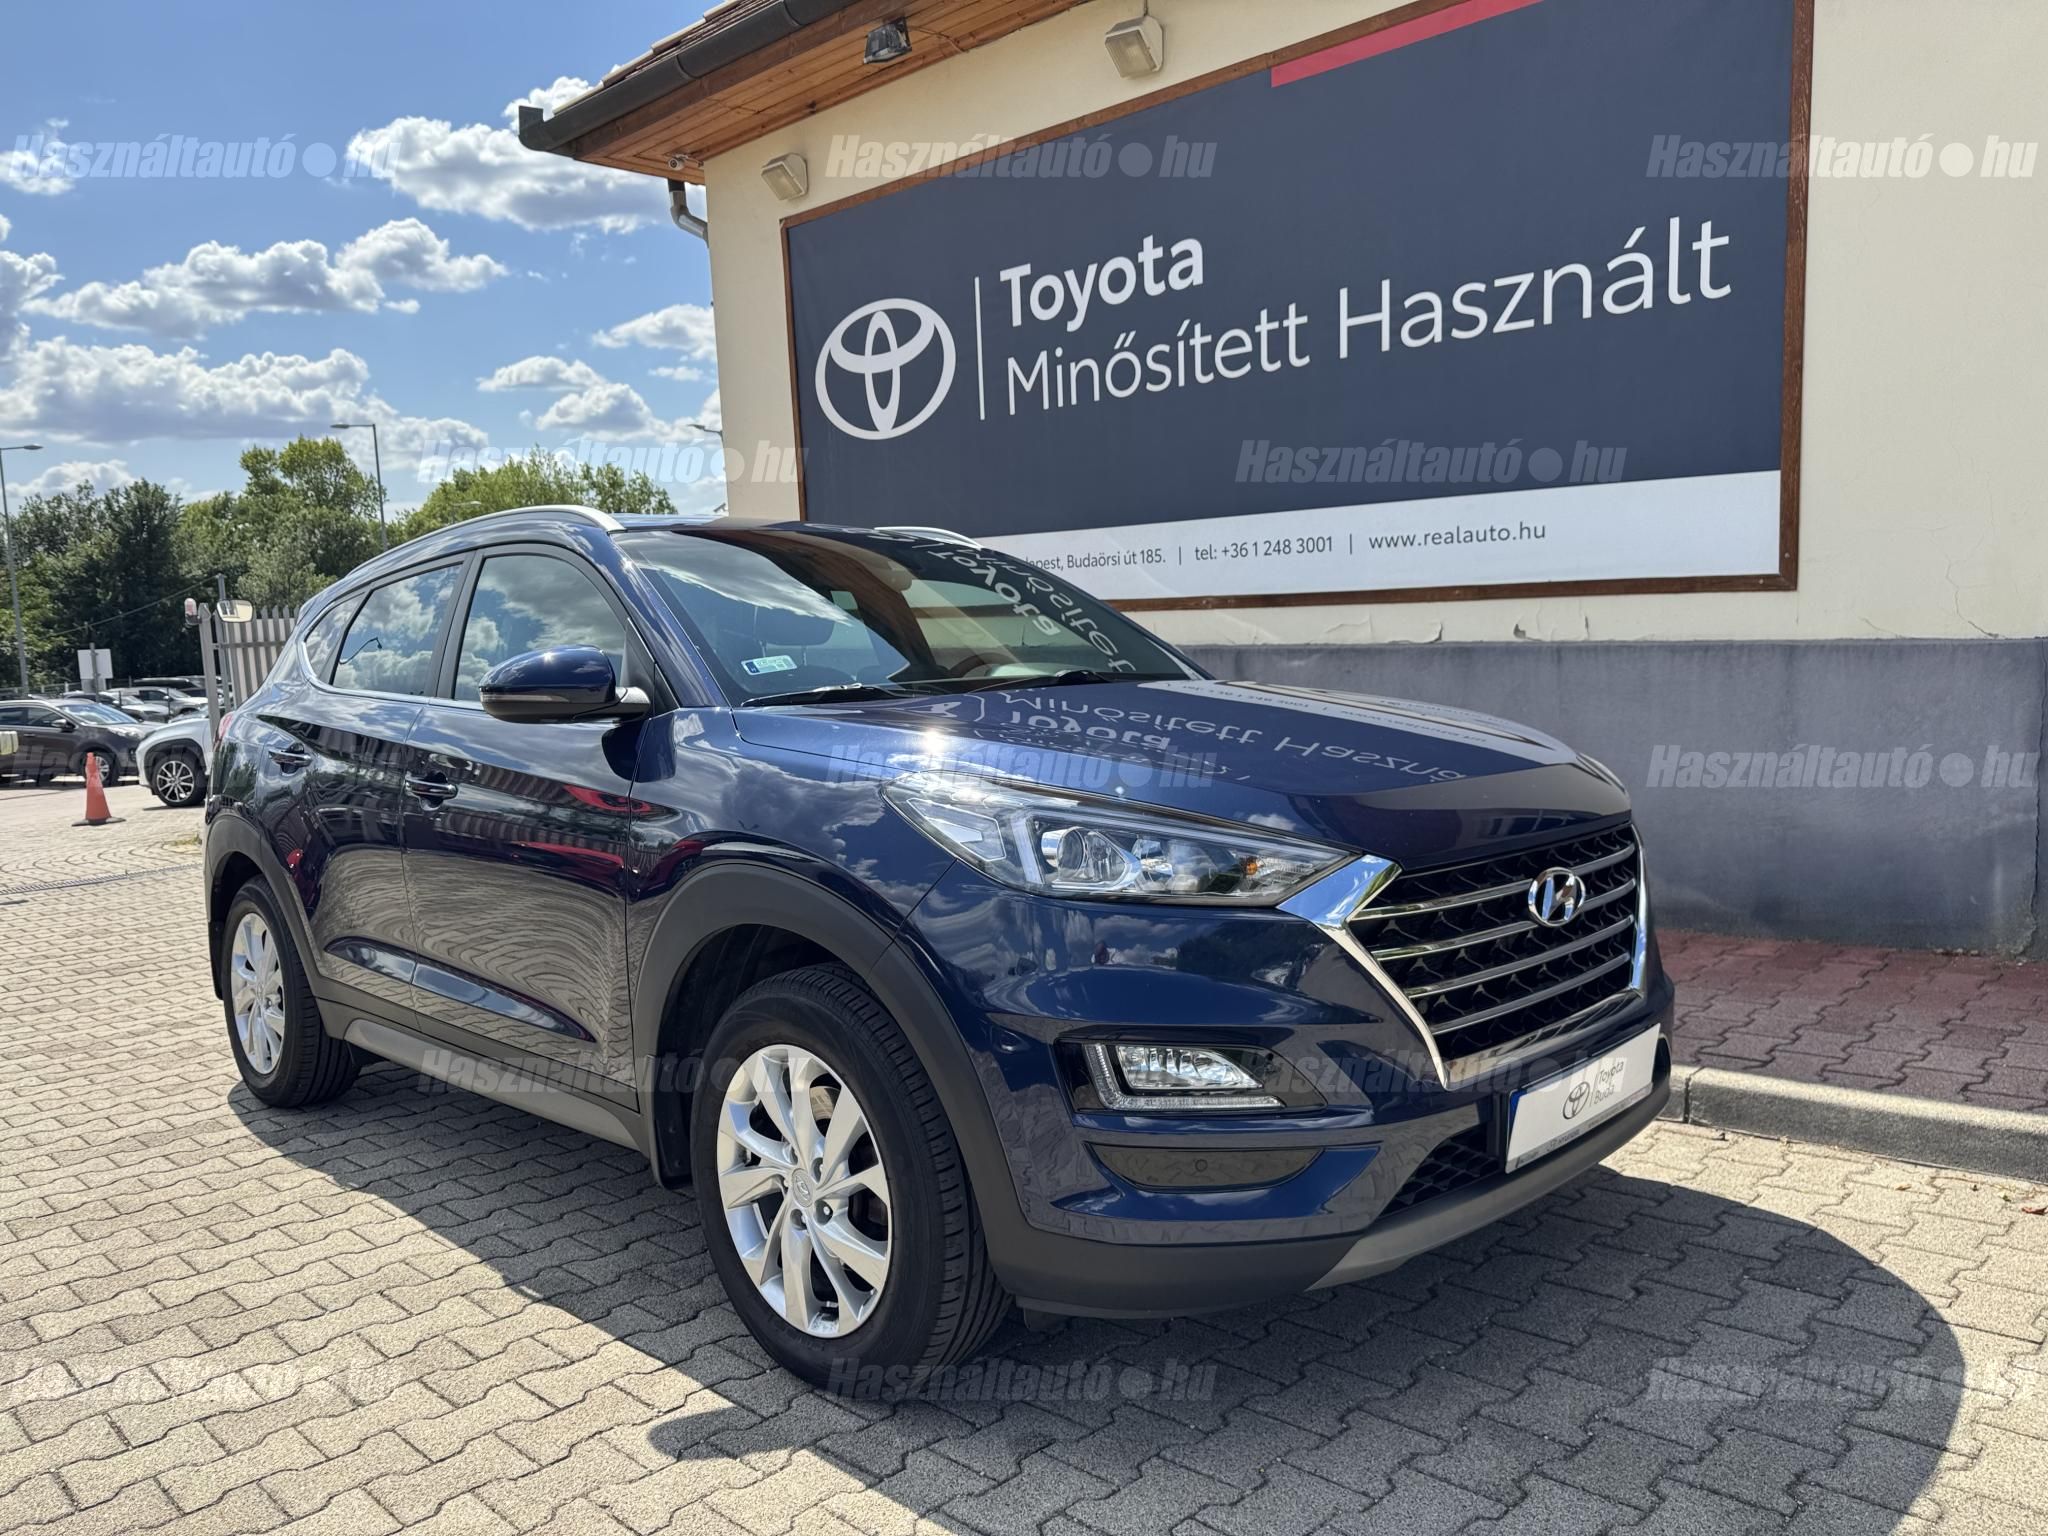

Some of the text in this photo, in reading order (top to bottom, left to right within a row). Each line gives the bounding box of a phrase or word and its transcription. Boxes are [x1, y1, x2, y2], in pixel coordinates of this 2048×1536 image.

[1000, 234, 1204, 332] Toyota
[1008, 216, 1732, 416] Minősített Használt
[1067, 553, 1121, 569] Budaörsi
[1123, 549, 1137, 565] út
[1140, 548, 1166, 563] 185.
[1194, 544, 1217, 560] tel:
[1221, 542, 1249, 558] +36
[1263, 538, 1292, 556] 248
[1296, 536, 1333, 554] 3001
[1368, 521, 1546, 549] www.realauto.hu
[1594, 1084, 1615, 1105] Buda
[1599, 1061, 1625, 1085] Toyota
